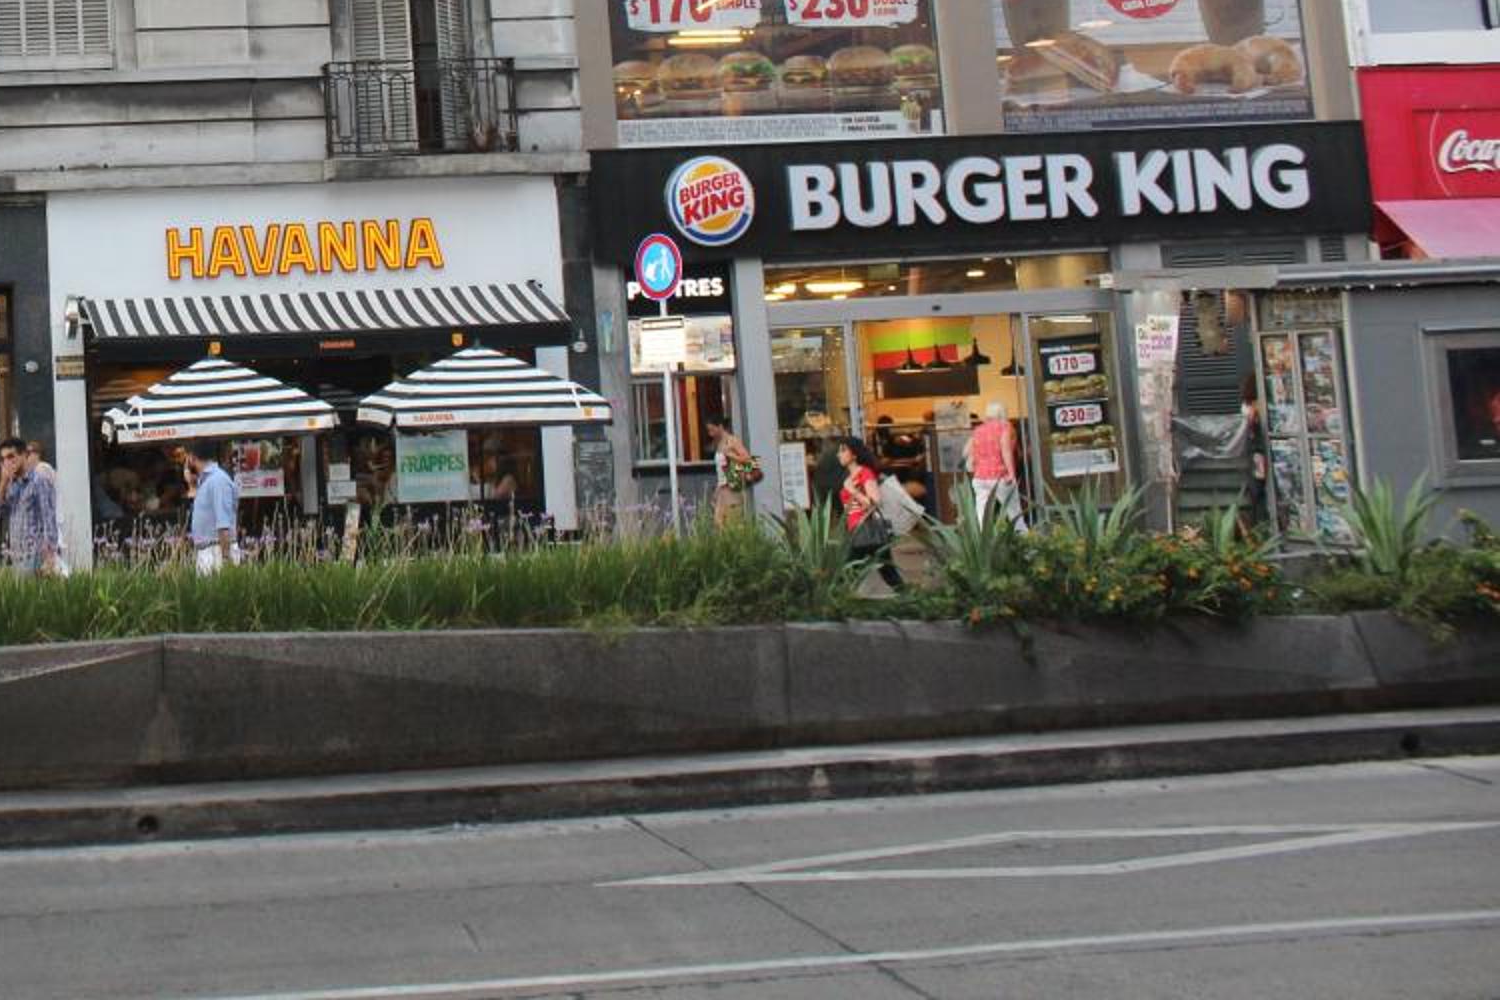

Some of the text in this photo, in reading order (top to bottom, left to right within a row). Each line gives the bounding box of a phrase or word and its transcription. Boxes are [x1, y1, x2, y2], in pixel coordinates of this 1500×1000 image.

[1439, 130, 1500, 172] Coca
[680, 171, 741, 204] BURGER
[683, 187, 745, 226] KING
[789, 144, 1311, 230] BURGER KING
[166, 218, 445, 279] HAVANNA
[628, 277, 724, 299] PTRES
